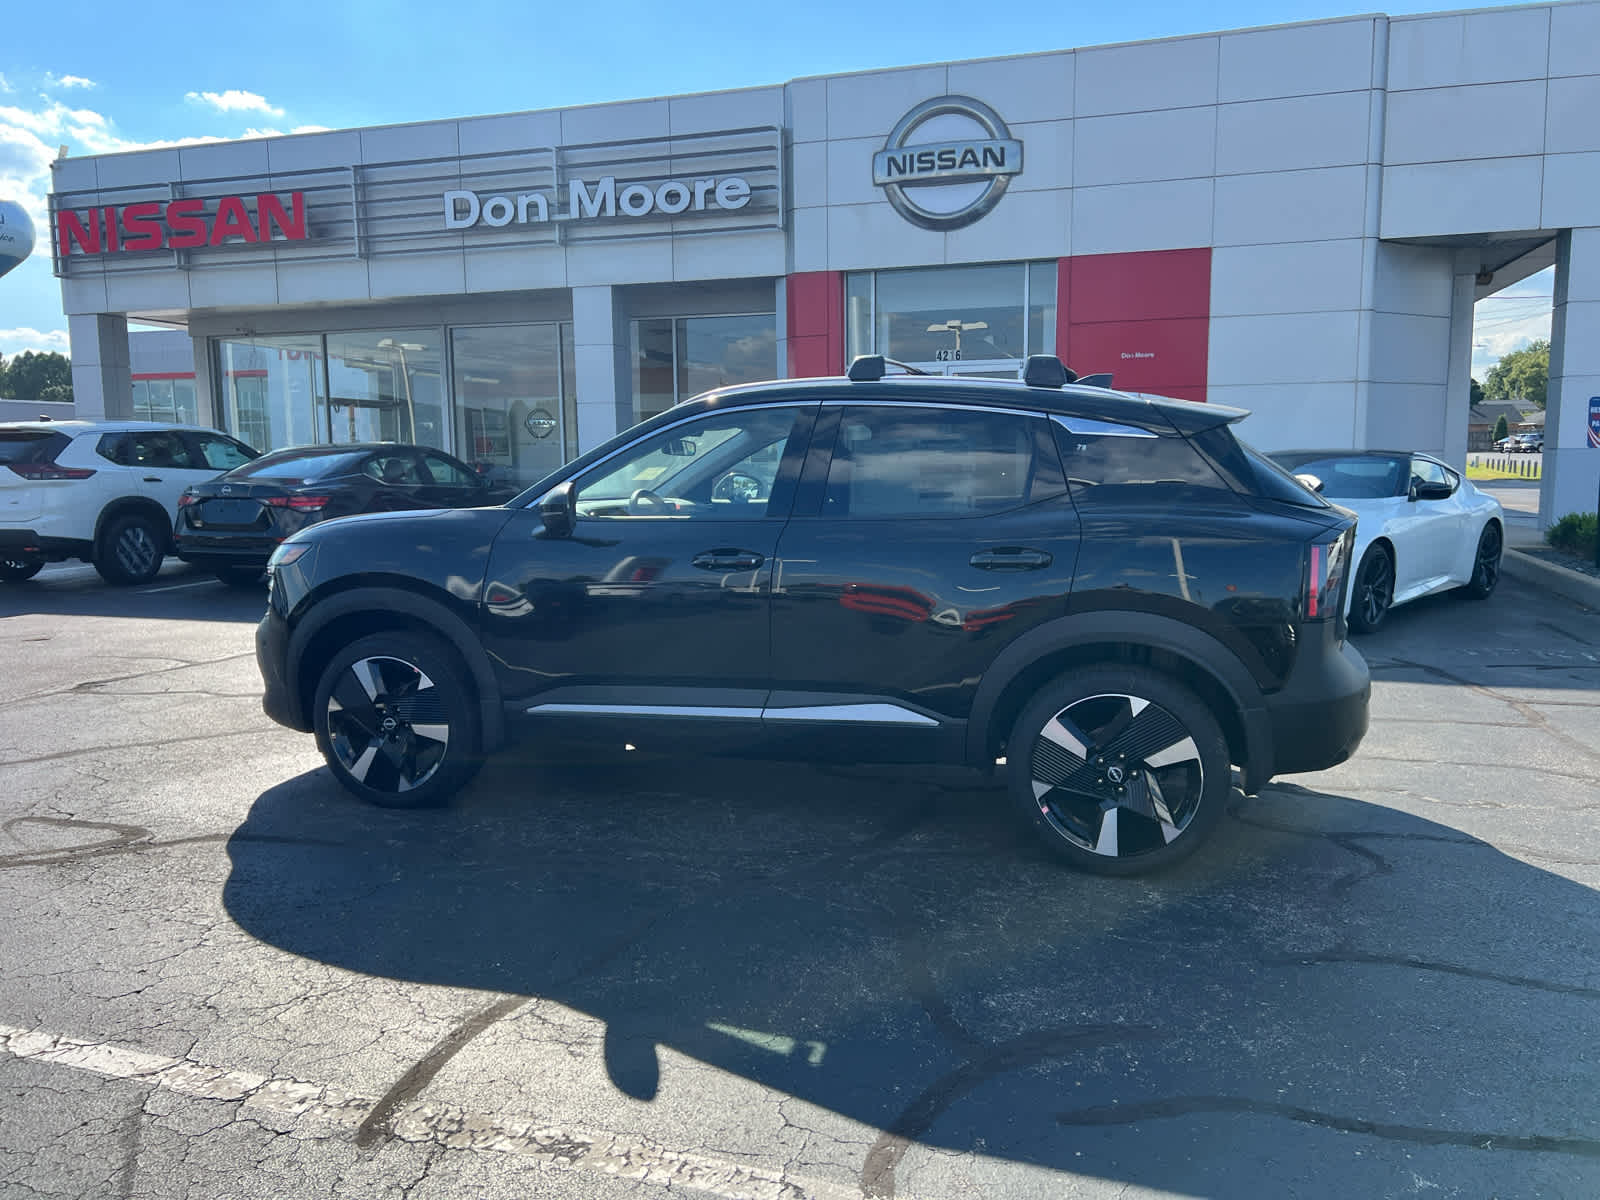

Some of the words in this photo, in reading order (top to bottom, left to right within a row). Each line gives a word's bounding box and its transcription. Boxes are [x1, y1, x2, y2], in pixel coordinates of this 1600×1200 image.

[887, 147, 1005, 176] NISSAN
[57, 191, 307, 257] NISSAN
[443, 189, 550, 230] Don
[568, 175, 752, 219] Moore
